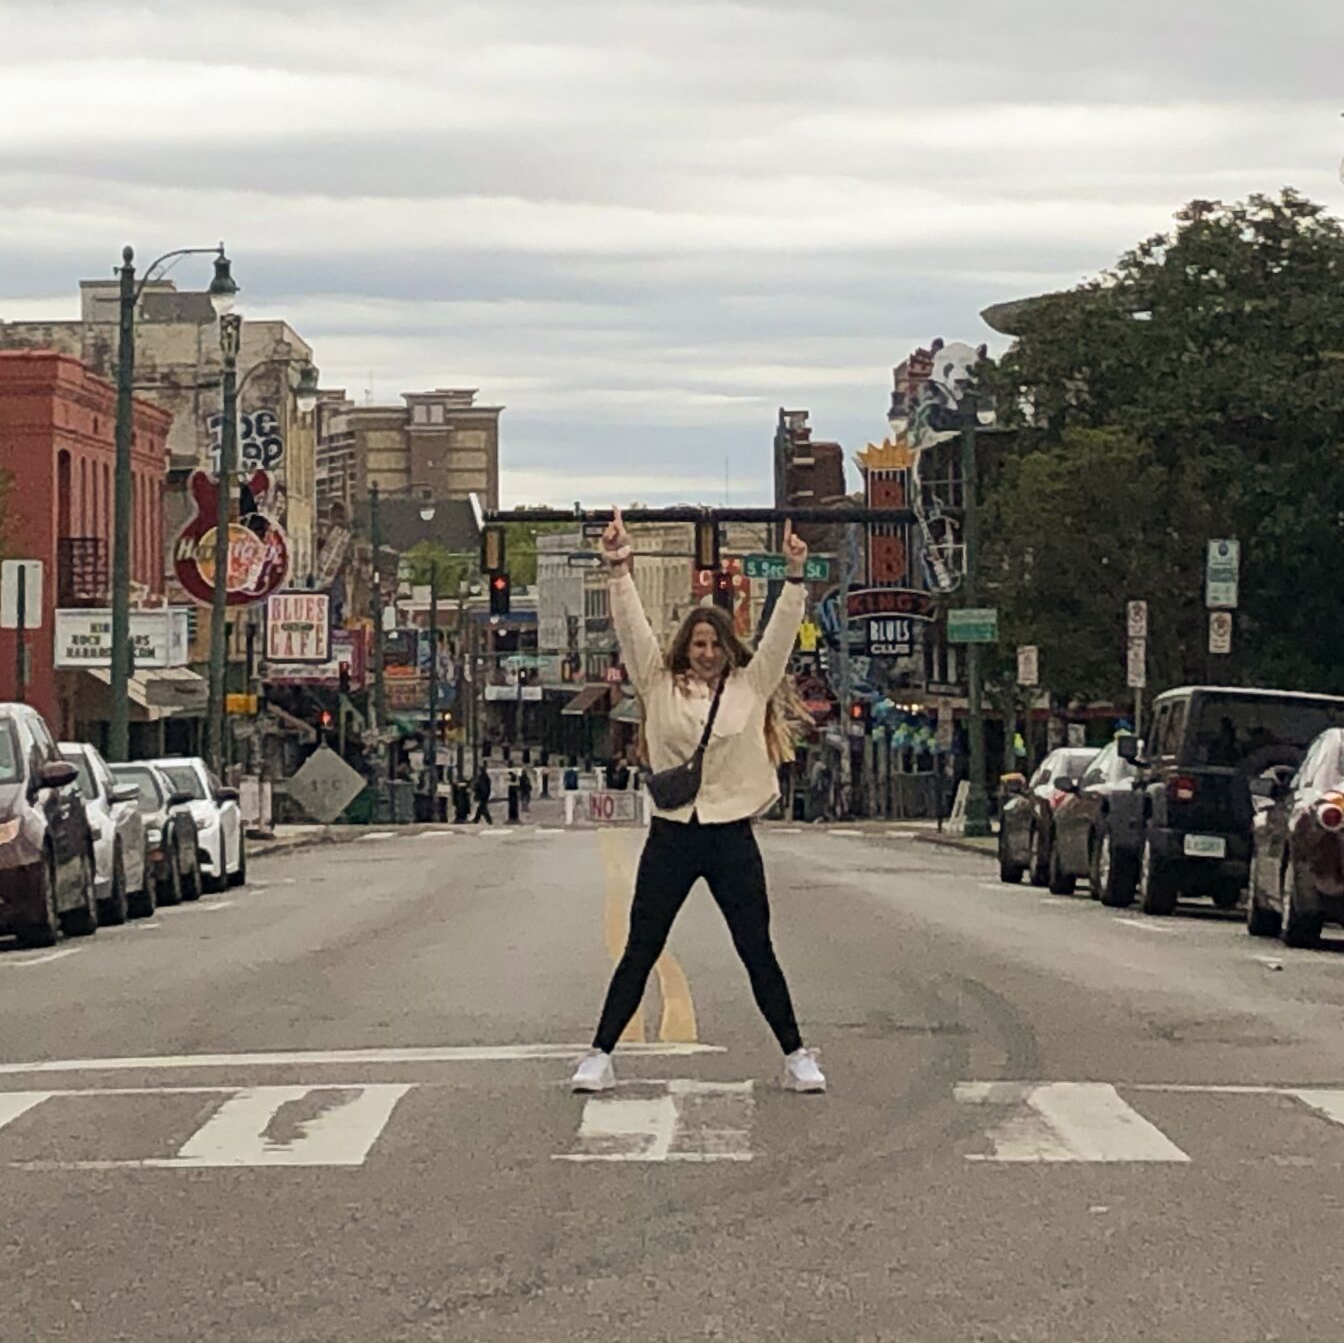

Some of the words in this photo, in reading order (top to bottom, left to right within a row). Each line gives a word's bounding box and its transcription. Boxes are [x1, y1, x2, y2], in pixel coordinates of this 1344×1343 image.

[271, 597, 326, 622] BLUES
[270, 623, 324, 656] CAFE
[870, 620, 910, 641] BLUES
[870, 643, 910, 654] CLUB
[591, 795, 615, 819] NO
